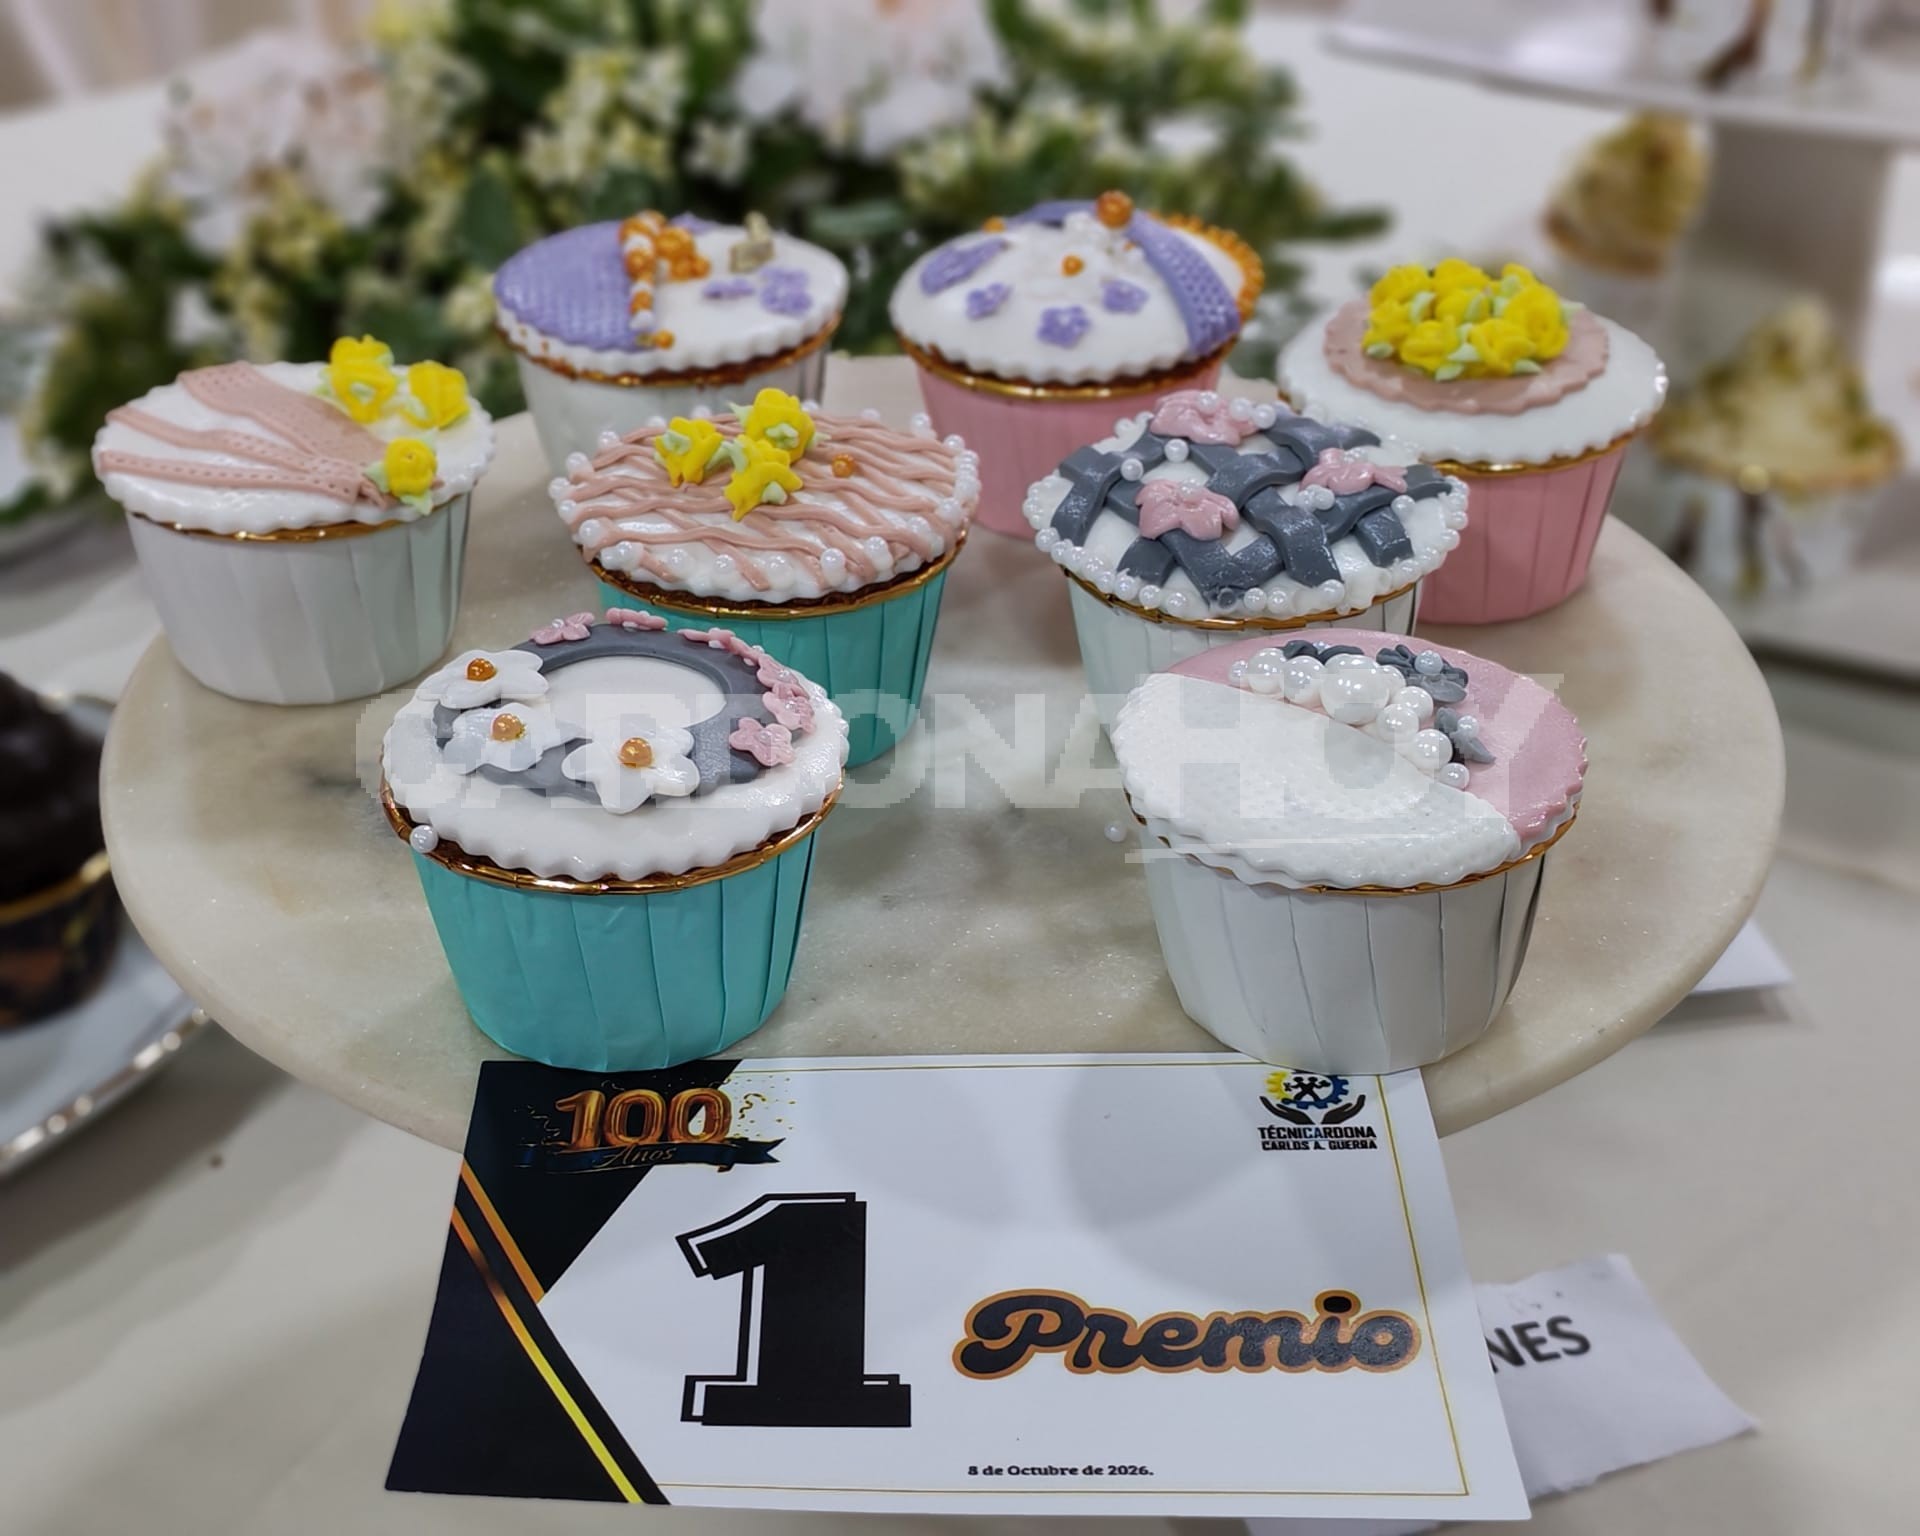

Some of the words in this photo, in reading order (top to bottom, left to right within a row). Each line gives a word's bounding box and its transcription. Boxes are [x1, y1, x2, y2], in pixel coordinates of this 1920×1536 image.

[555, 1087, 733, 1150] 100
[1257, 1125, 1377, 1139] TÉCNICARDONA
[1261, 1140, 1310, 1151] CARLOS
[1313, 1140, 1326, 1150] A.
[1328, 1140, 1378, 1150] GUERRA
[675, 1192, 912, 1427] 1
[952, 1288, 1422, 1380] Premio
[967, 1465, 979, 1476] 8
[982, 1465, 1003, 1476] de
[1007, 1465, 1079, 1476] Octubre
[1082, 1465, 1104, 1476] de
[1107, 1465, 1154, 1476] 2026.
